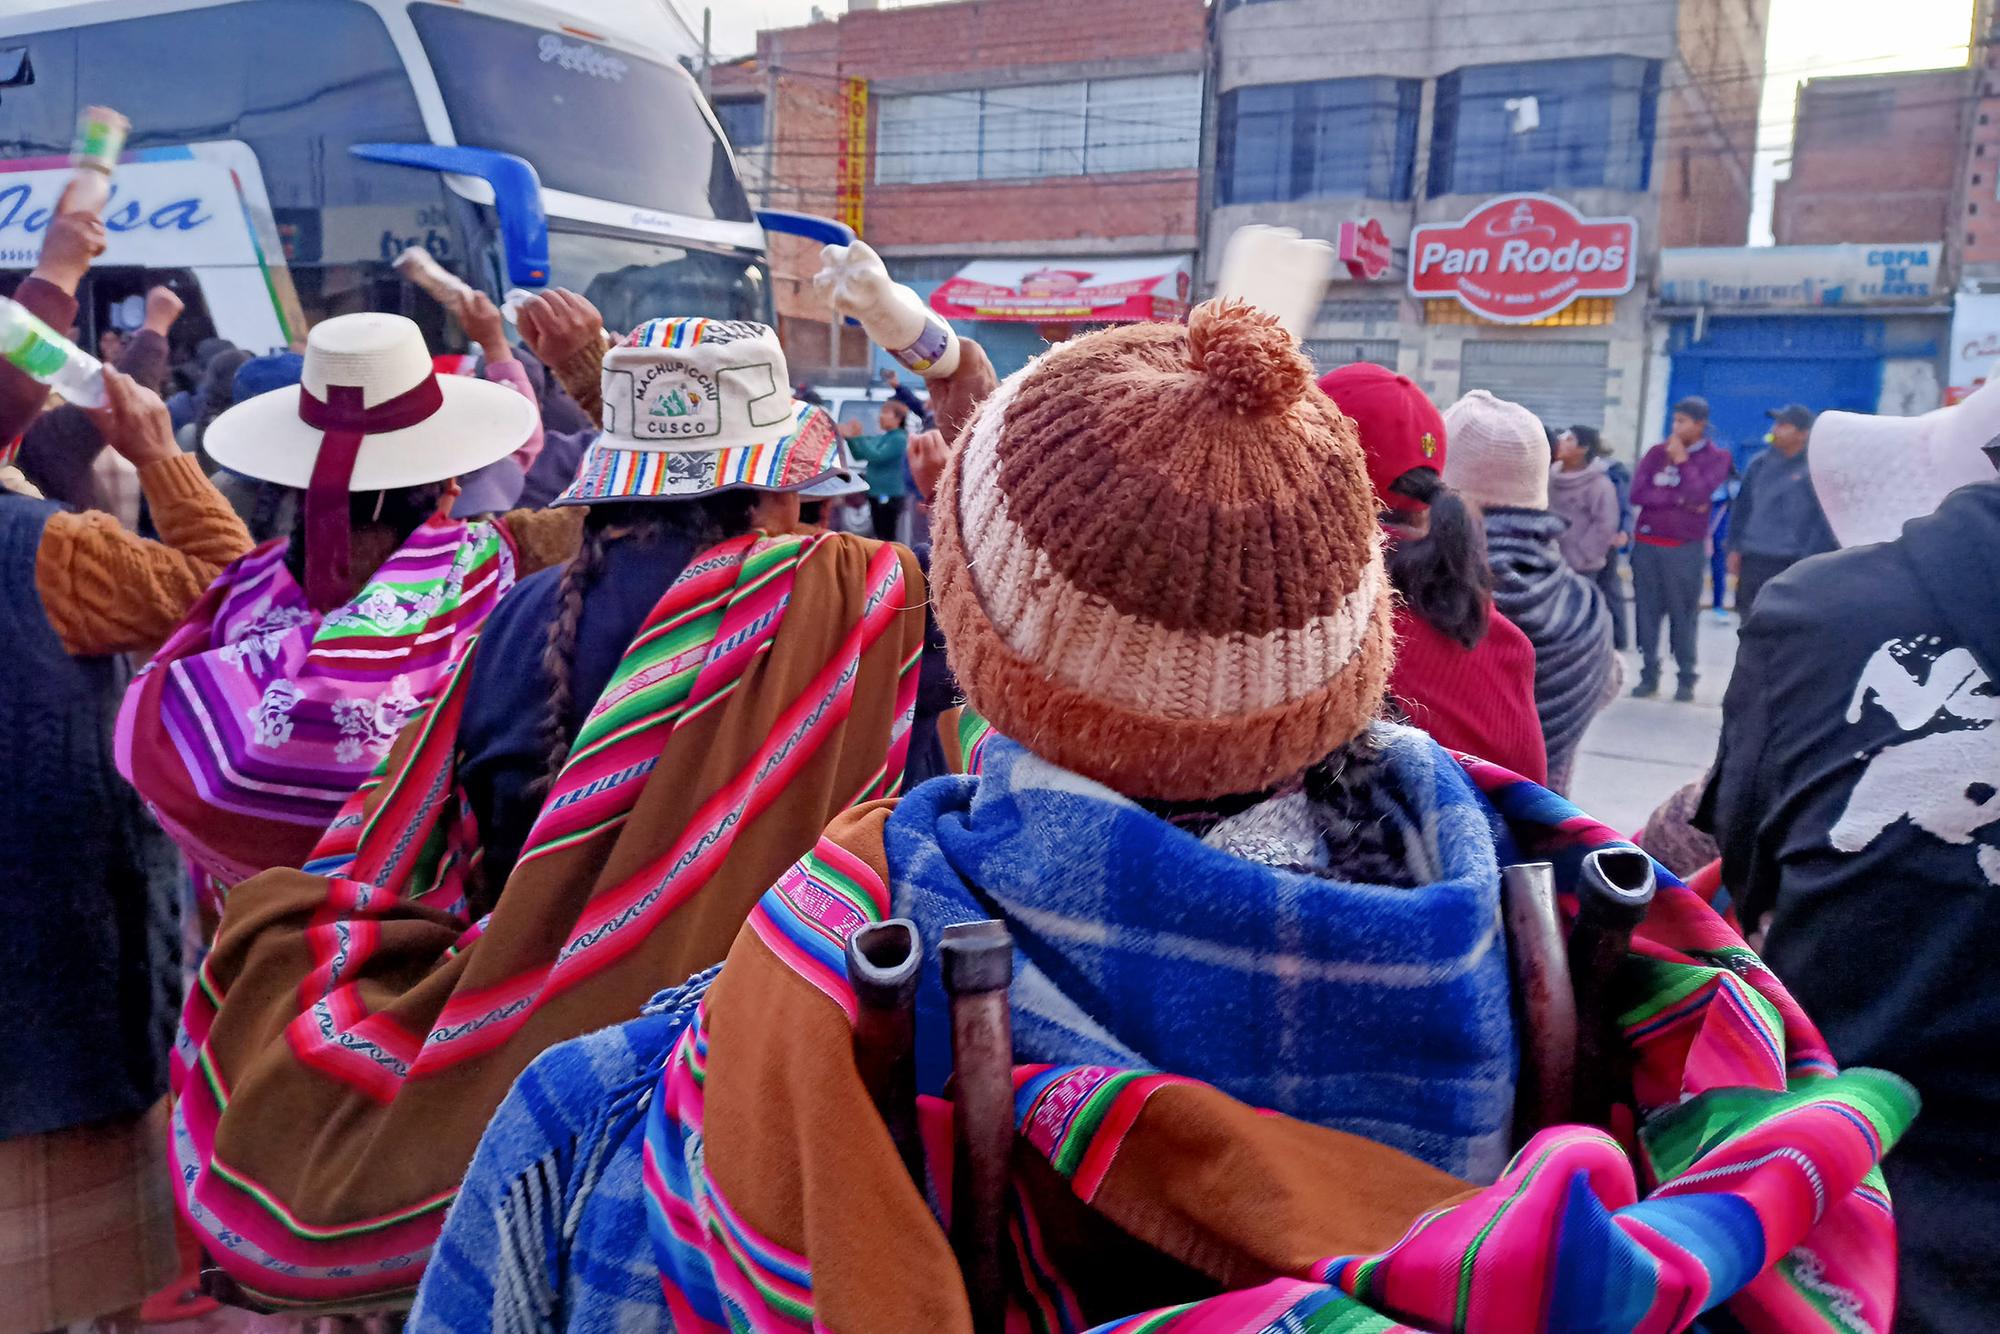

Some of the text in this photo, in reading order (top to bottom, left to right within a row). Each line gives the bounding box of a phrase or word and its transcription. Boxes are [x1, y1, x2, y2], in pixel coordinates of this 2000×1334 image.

[0, 184, 212, 232] Jsa
[1419, 242, 1489, 274] Pan
[1499, 238, 1626, 274] Rodos
[1867, 250, 1929, 266] COPIA
[635, 362, 718, 401] MACHUPICCHU
[648, 421, 706, 434] CUSCO
